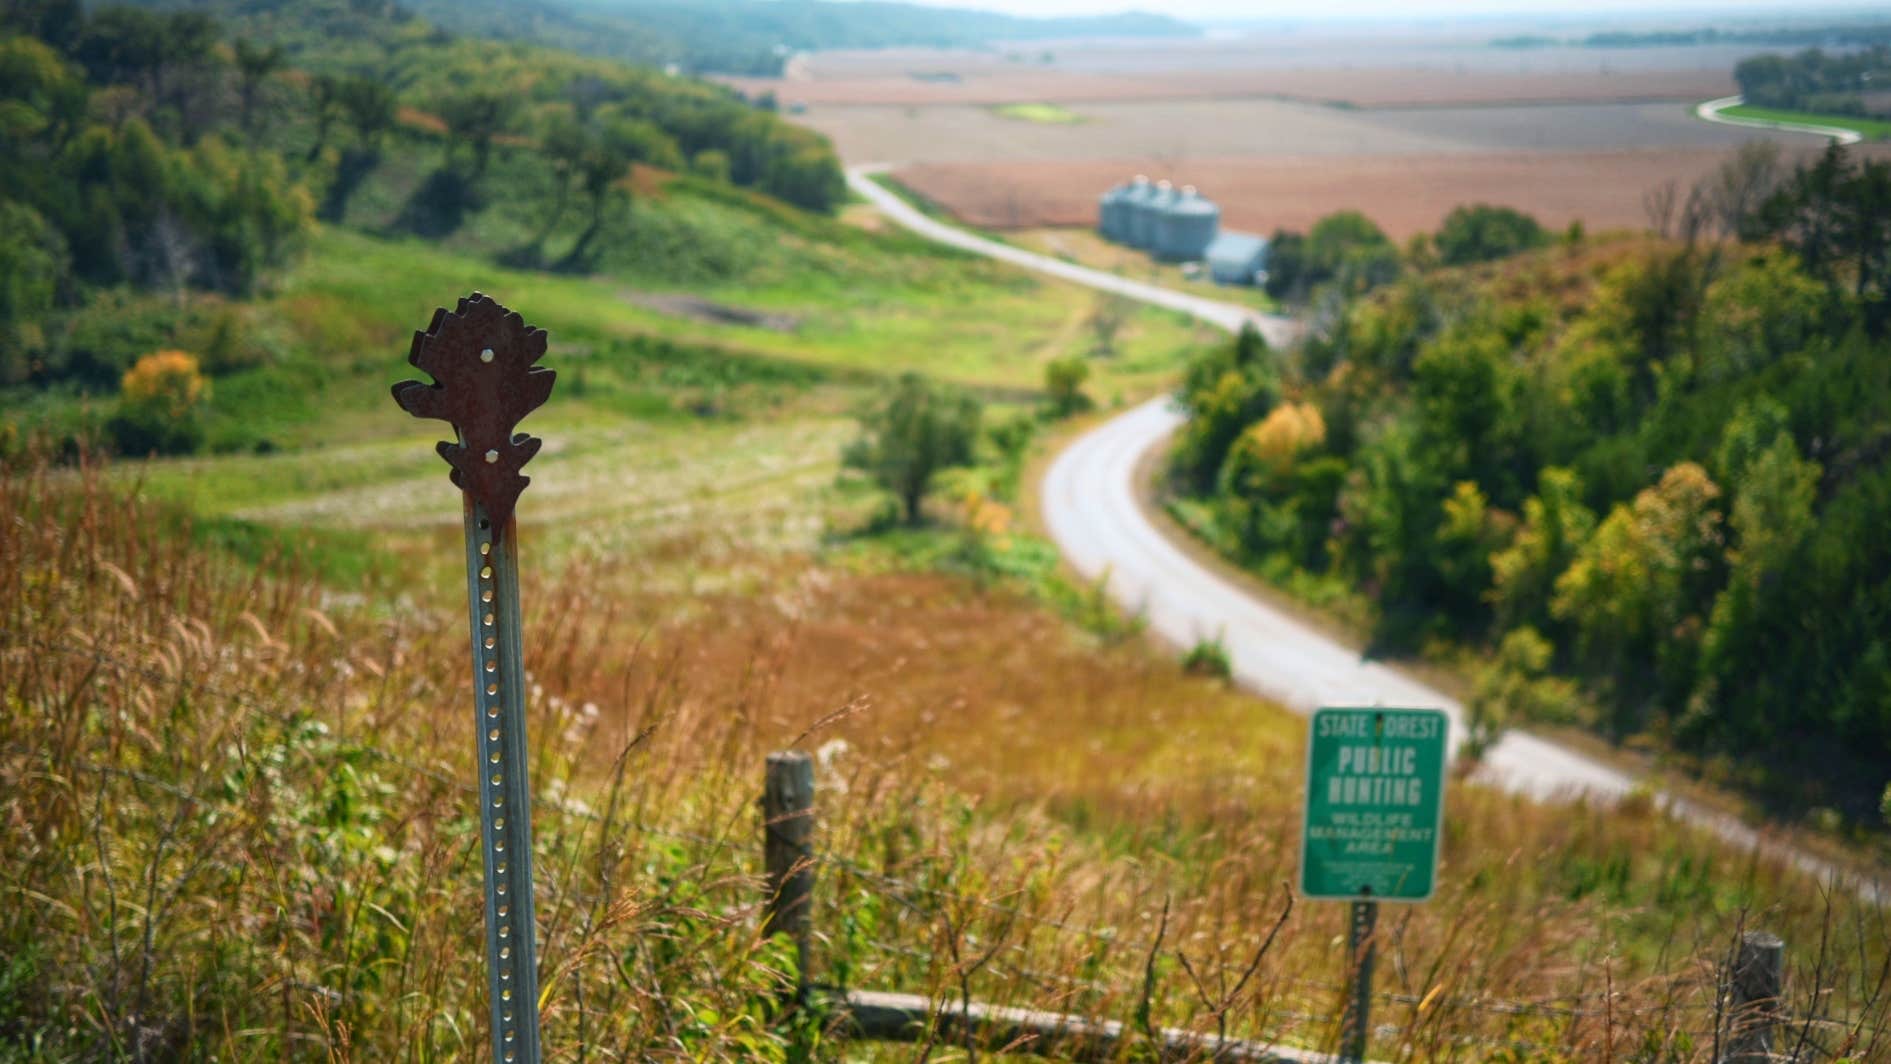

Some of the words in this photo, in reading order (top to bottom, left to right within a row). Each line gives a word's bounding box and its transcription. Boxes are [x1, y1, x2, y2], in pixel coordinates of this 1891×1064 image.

[1320, 714, 1369, 737] STATE
[1338, 746, 1417, 774] PUBLIC
[1328, 776, 1422, 806] HUNTING
